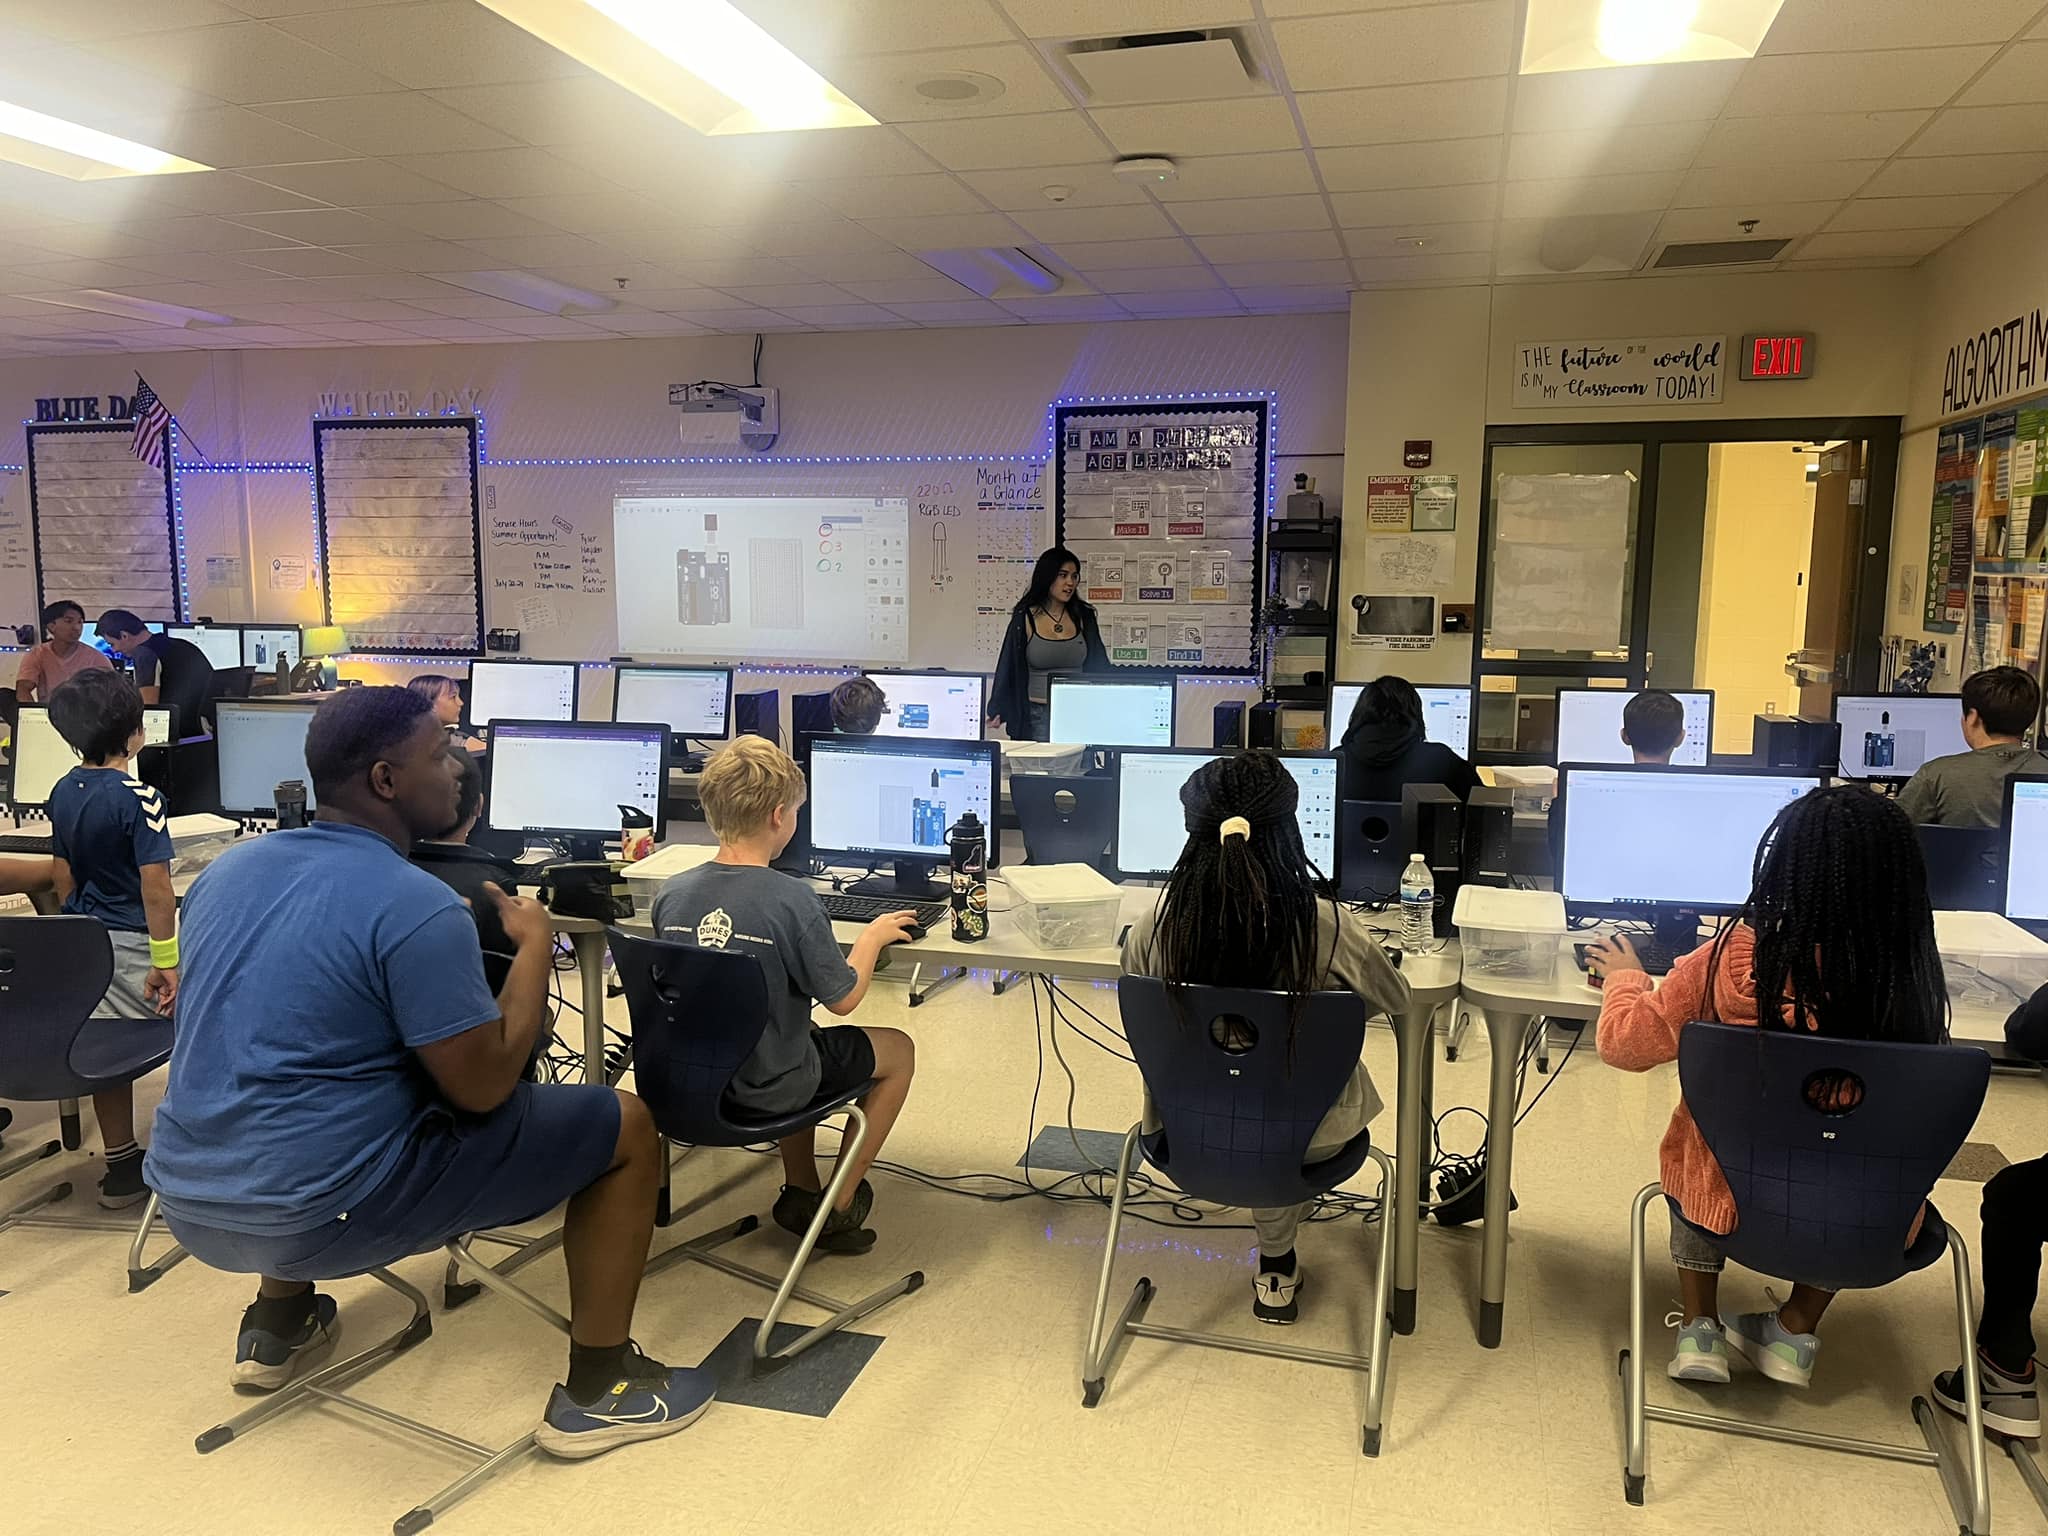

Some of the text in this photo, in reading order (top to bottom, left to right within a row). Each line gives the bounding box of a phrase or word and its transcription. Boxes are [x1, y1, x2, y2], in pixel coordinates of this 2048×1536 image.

[1522, 346, 1552, 368] THE
[1560, 346, 1622, 373] future
[1653, 341, 1721, 371] world
[1752, 338, 1804, 376] EXIT
[1942, 308, 2048, 416] ALGORITHM
[1521, 373, 1529, 387] IS
[1532, 370, 1543, 387] IN
[1543, 385, 1558, 399] MY
[1655, 372, 1716, 400] TODAY!
[431, 386, 482, 416] DAY
[35, 397, 99, 422] BLUE
[1070, 432, 1138, 447] I AM A
[1087, 454, 1127, 468] AGE
[977, 467, 1041, 485] Month at
[1369, 476, 1410, 484] EMERGENCY
[979, 486, 1041, 499] a Glance
[919, 503, 961, 517] RGB LED
[491, 530, 517, 539] Summer
[1141, 590, 1160, 598] Solve
[1169, 651, 1187, 659] Find
[700, 926, 729, 938] DUNES
